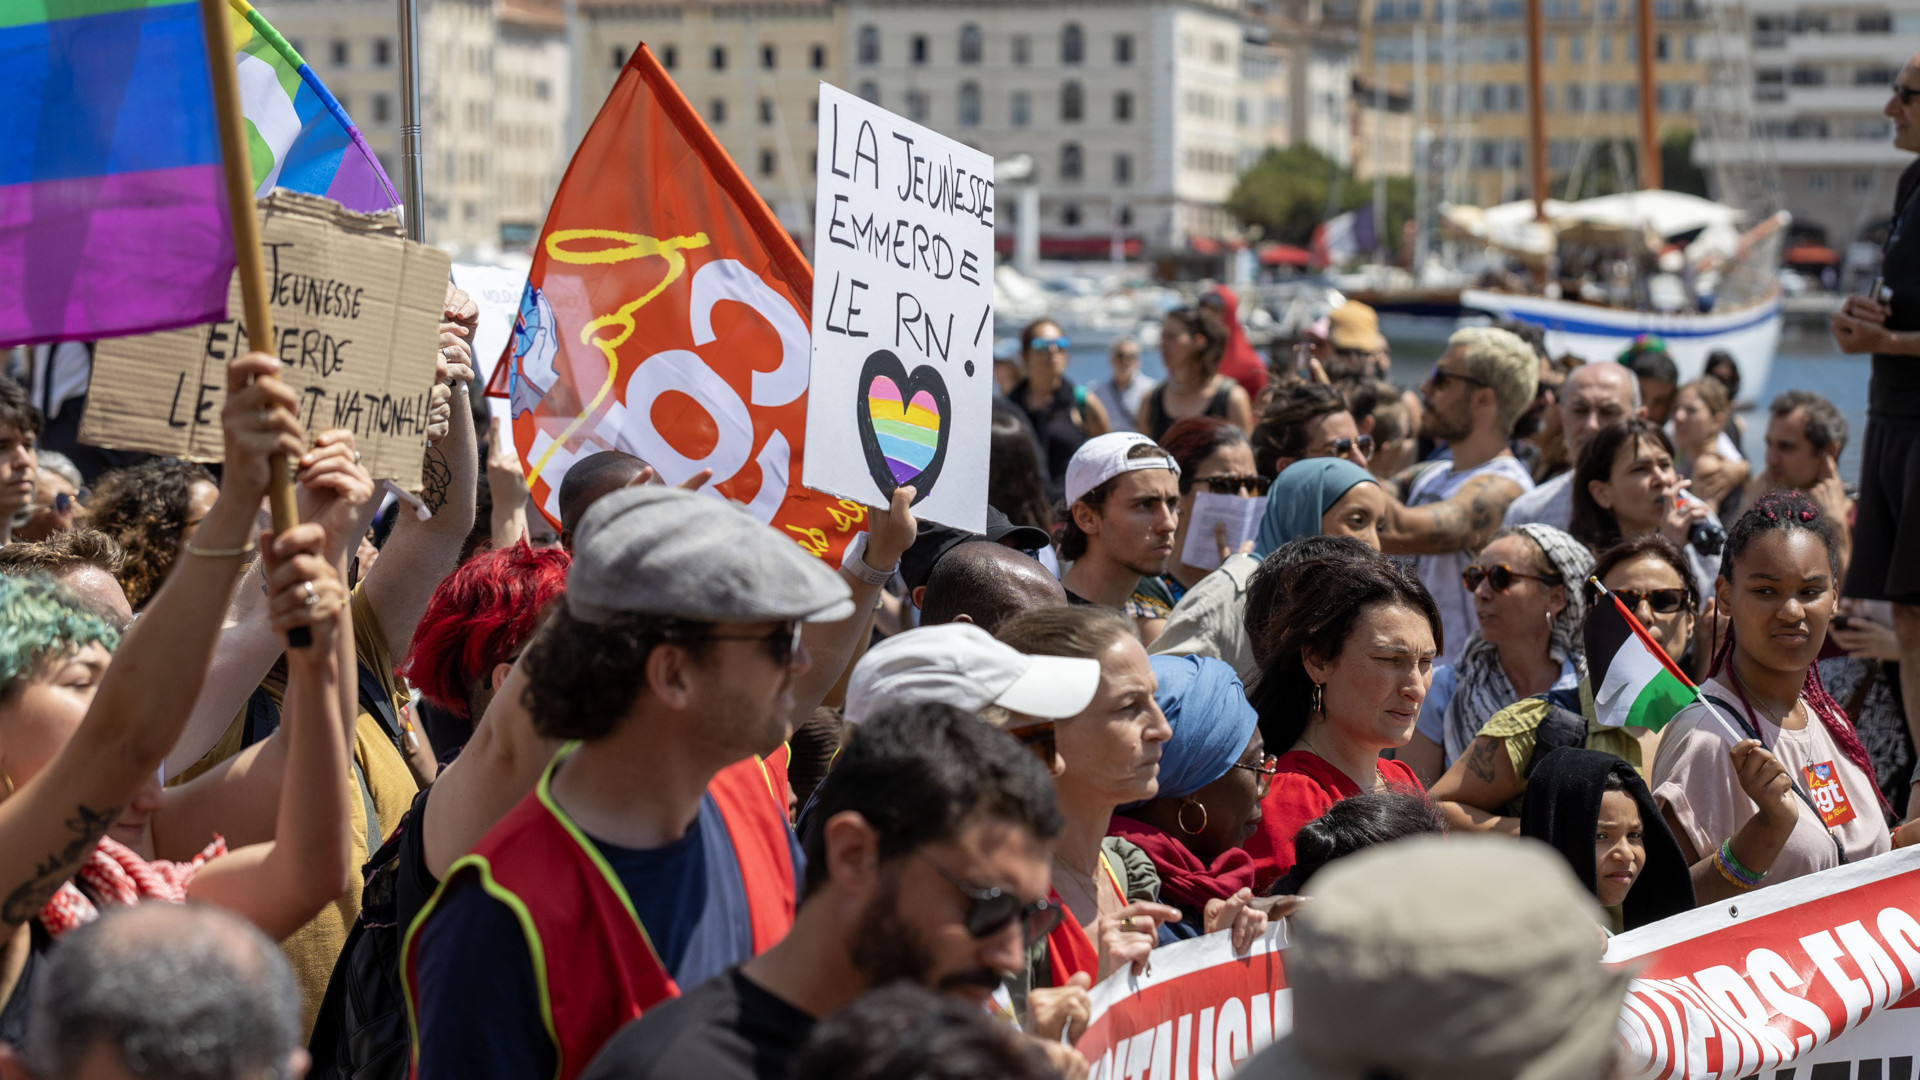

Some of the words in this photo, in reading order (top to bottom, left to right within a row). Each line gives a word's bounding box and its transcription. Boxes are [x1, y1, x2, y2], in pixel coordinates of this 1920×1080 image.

[832, 104, 879, 189] LA
[892, 131, 994, 228] JEUNESSE
[263, 242, 364, 320] JEUNESSE
[829, 194, 980, 287] EMMERDE
[207, 319, 353, 378] EERDE
[826, 271, 869, 338] LE
[896, 292, 955, 362] RN
[168, 371, 221, 428] LE
